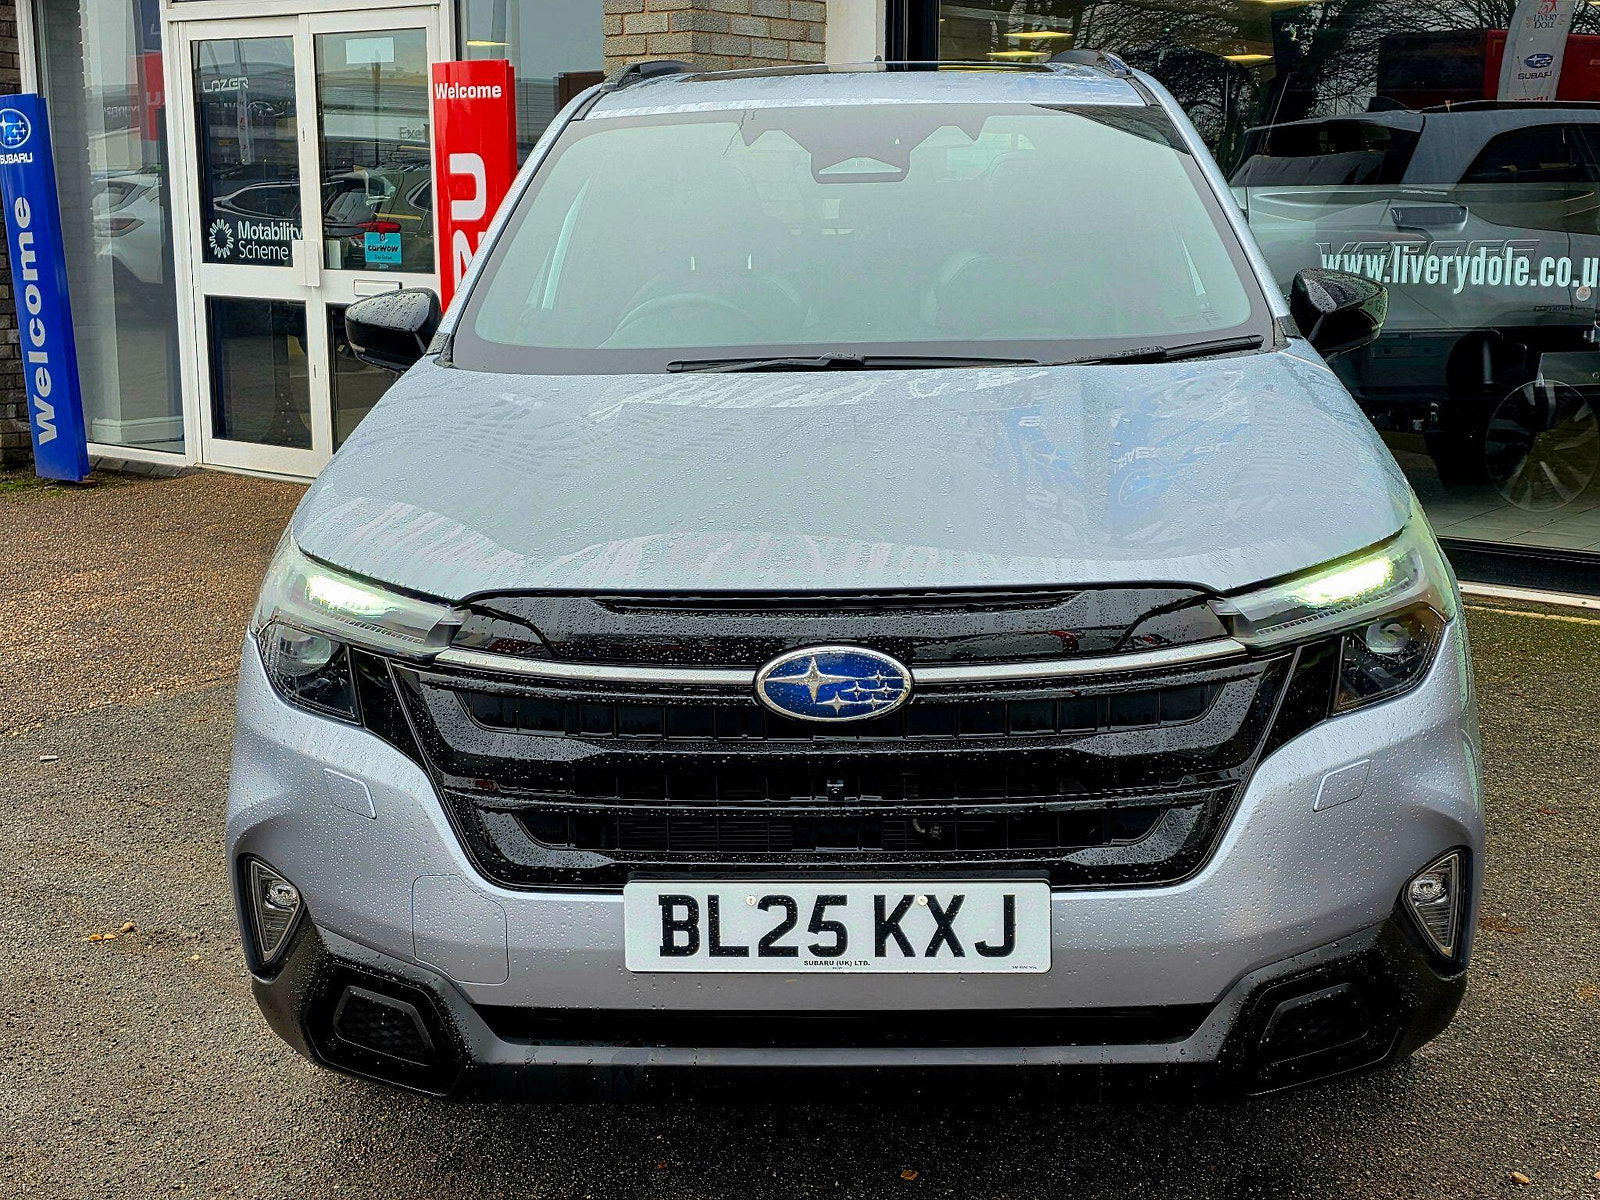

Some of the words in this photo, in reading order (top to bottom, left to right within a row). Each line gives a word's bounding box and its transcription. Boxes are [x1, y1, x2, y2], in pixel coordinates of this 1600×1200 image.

[435, 82, 502, 99] Welcome
[400, 126, 423, 139] Exe
[0, 152, 33, 164] SUBARU
[237, 220, 304, 241] Motability
[238, 240, 289, 260] Scheme
[1322, 246, 1600, 294] www.liverydole.co.u
[14, 196, 58, 446] Welcome
[658, 894, 848, 958] BL25
[874, 894, 1016, 958] KXJ
